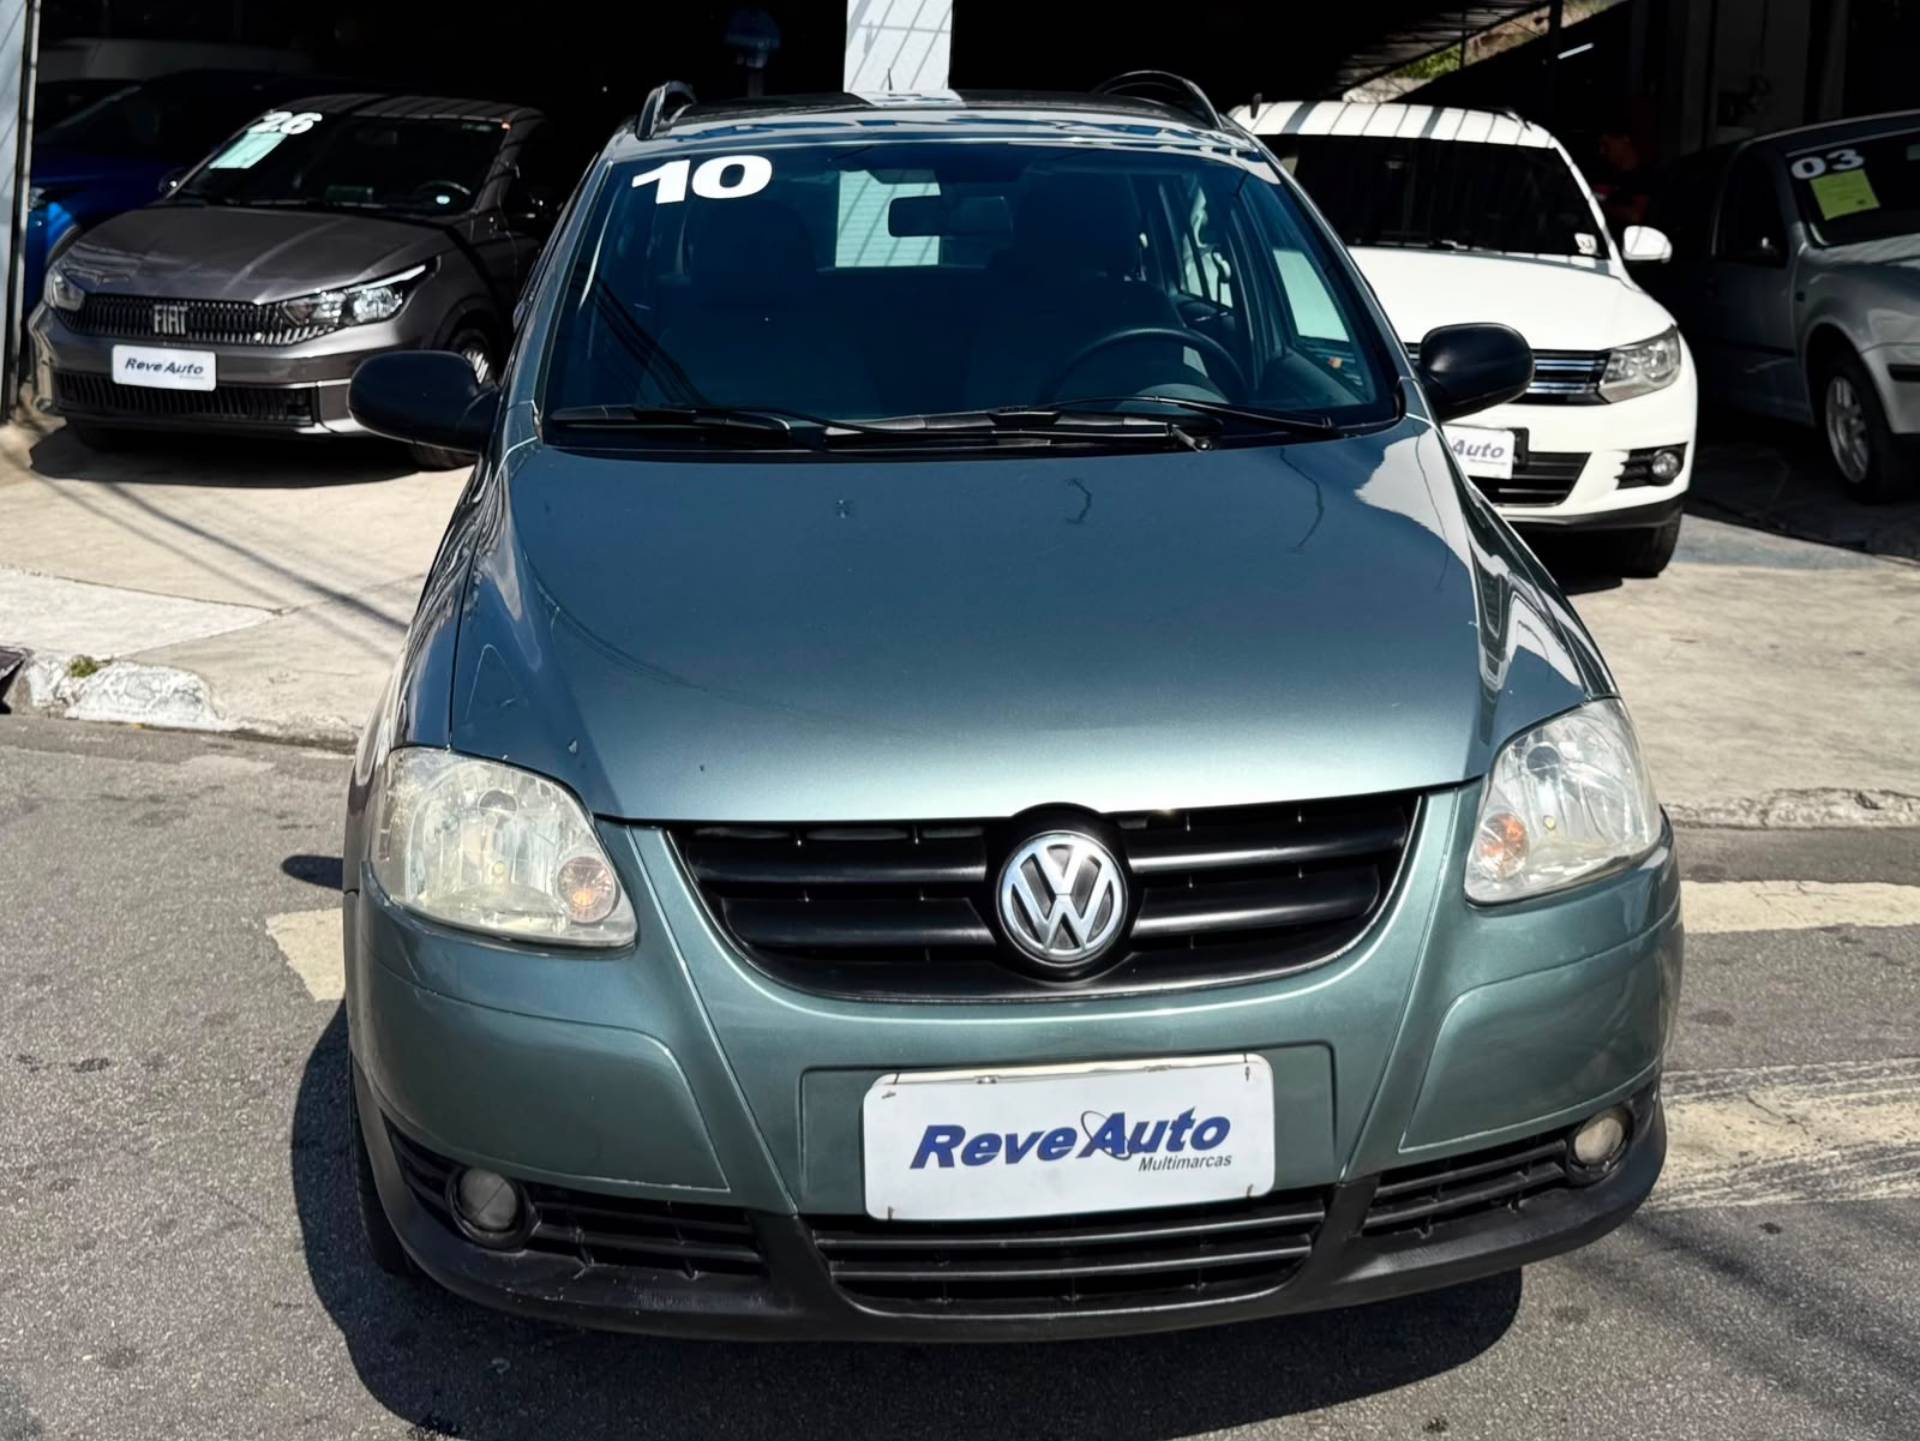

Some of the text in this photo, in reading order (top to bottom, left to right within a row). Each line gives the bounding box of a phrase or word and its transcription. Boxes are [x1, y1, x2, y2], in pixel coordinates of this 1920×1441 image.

[247, 111, 323, 135] 26
[1791, 148, 1865, 179] 03
[631, 154, 773, 205] 10
[153, 304, 189, 335] FIAT
[125, 357, 204, 375] Reve Auto
[1452, 438, 1505, 459] Auto
[998, 831, 1126, 965] VW
[909, 1106, 1232, 1170] Reve Auto
[1138, 1153, 1232, 1172] Multimarcas
